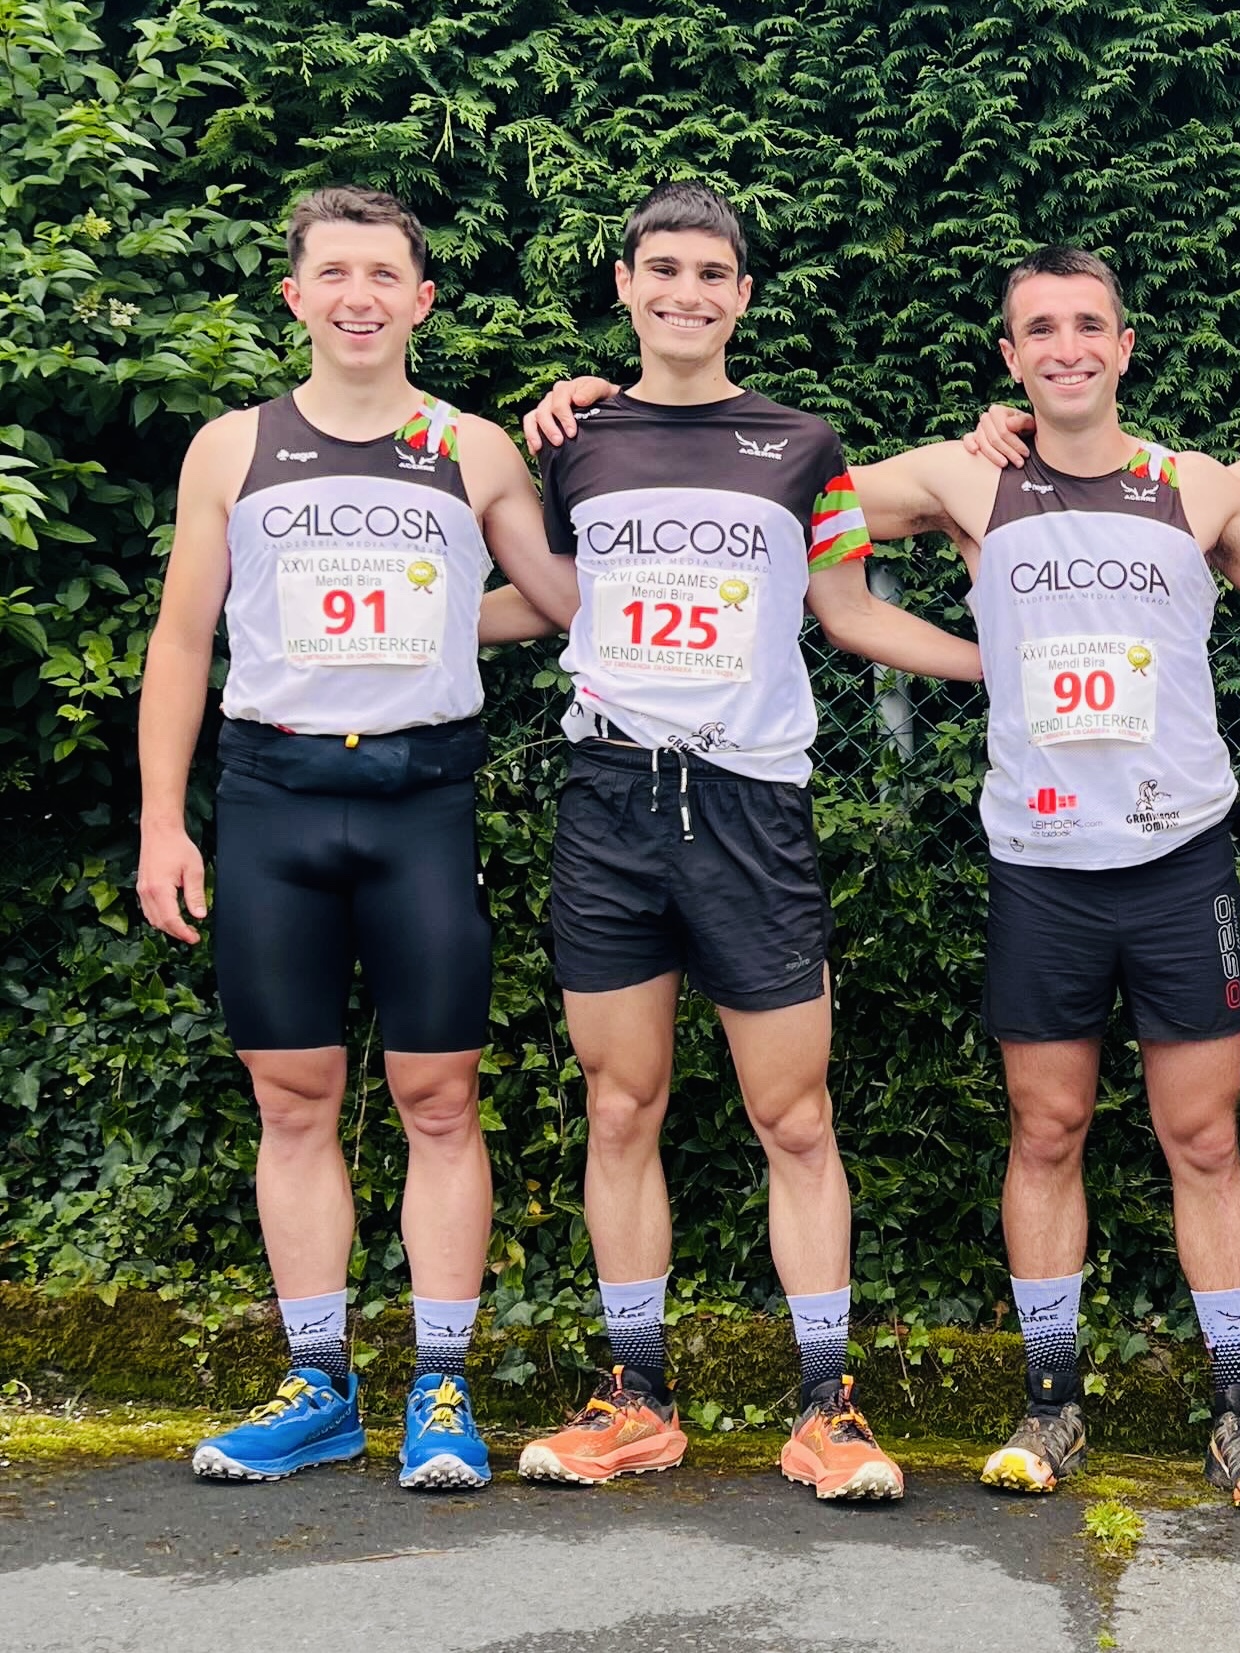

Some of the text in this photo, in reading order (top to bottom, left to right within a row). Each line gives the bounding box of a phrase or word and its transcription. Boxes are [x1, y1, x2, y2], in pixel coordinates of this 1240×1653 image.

[262, 503, 449, 547] CALCOSA
[587, 519, 772, 566] CALCOSA
[281, 558, 406, 574] XXVI GALDAMES
[316, 574, 382, 587] Mendi Bira
[600, 569, 719, 589] XXVI GALDAMES
[1011, 558, 1171, 597] CALCOSA
[631, 586, 695, 601] Mendi Bira
[323, 589, 387, 635] 91
[622, 600, 720, 650] 125
[288, 637, 437, 654] MENDI LASTERKETA
[1021, 642, 1127, 662] XXVI GALDAMES
[599, 645, 745, 670] MENDI LASTERKETA
[1048, 657, 1106, 671] Mendi Bira
[1053, 670, 1116, 715] 90
[1030, 713, 1150, 735] MENDI LASTERKETA
